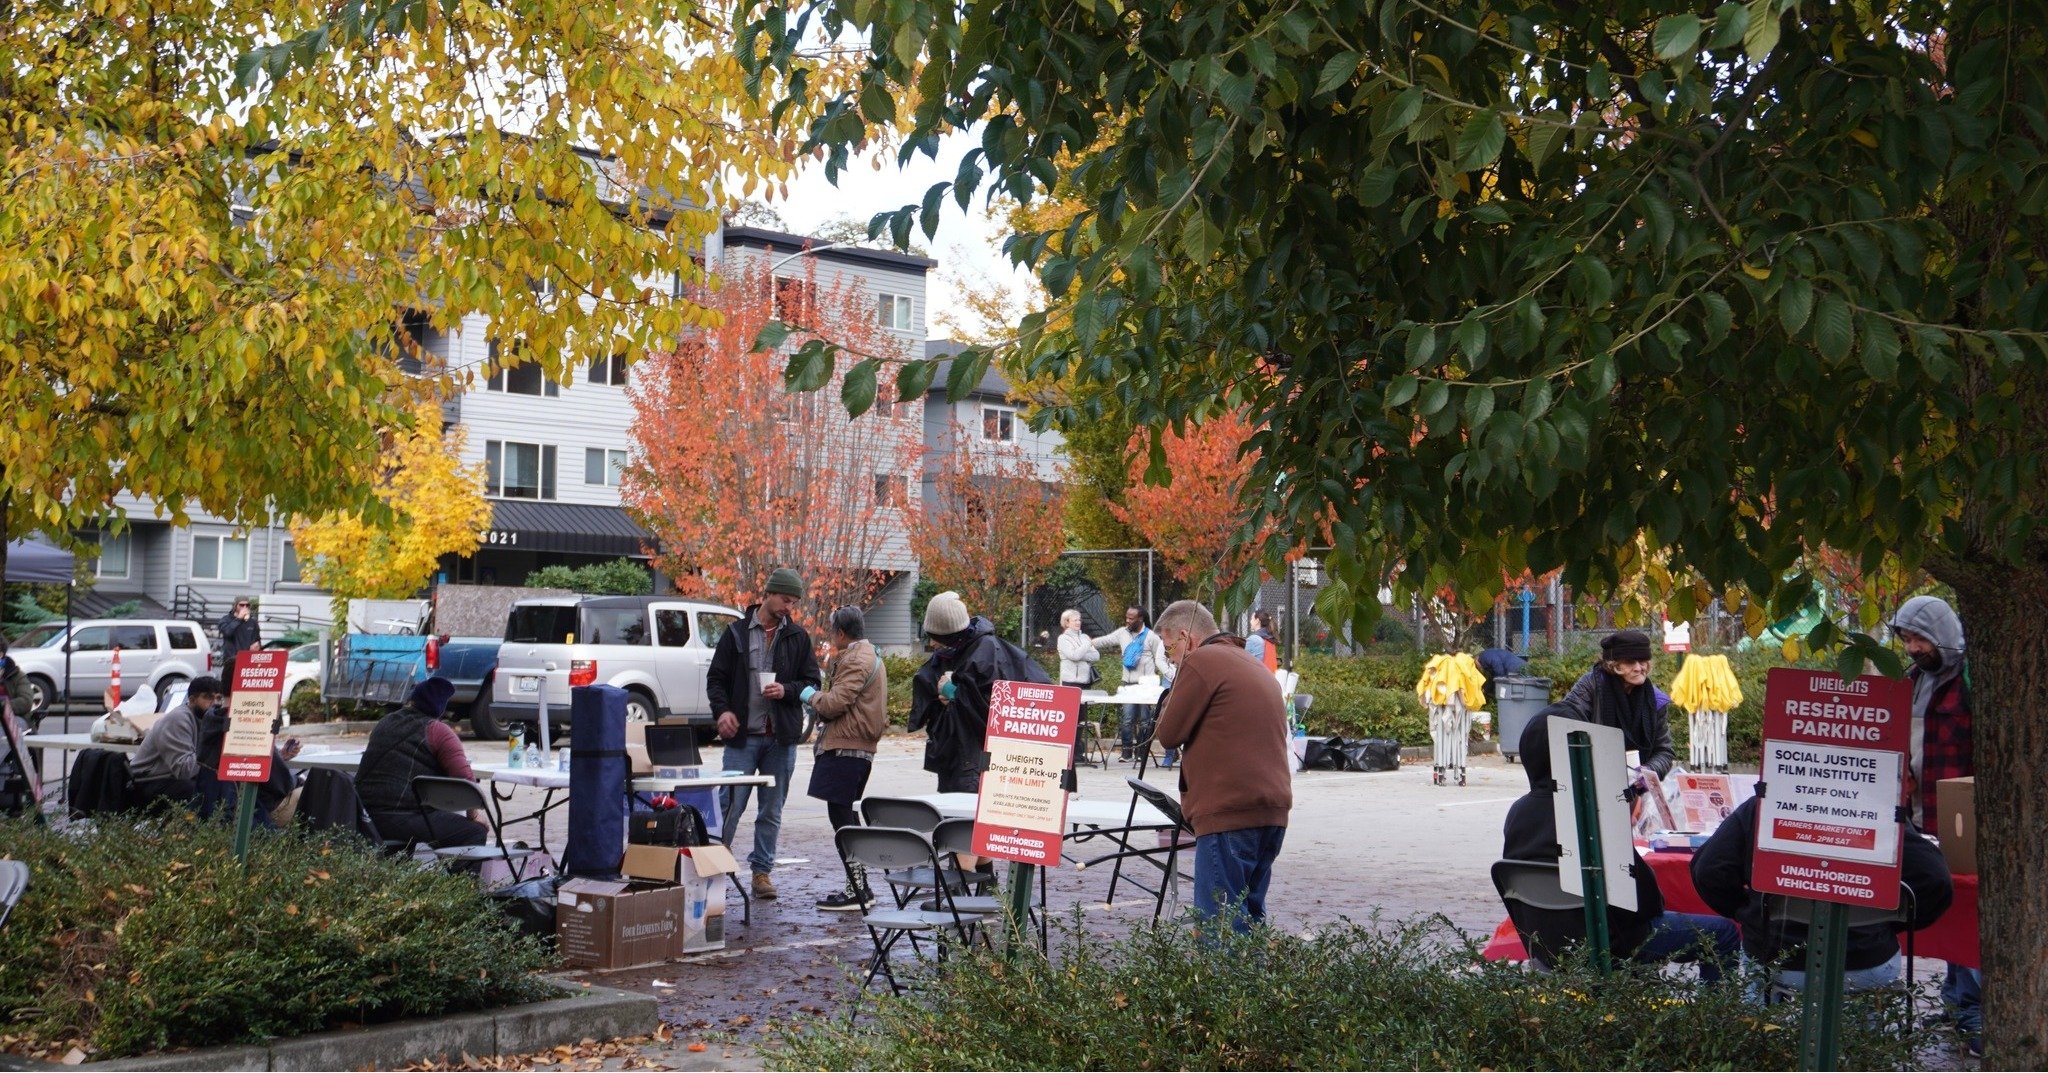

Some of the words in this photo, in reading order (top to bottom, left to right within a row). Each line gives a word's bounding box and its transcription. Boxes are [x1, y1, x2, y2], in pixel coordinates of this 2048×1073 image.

[480, 531, 517, 545] 5021
[241, 668, 278, 678] RESERVED
[242, 678, 274, 688] PARKING
[1017, 687, 1054, 700] UHEIGHTS
[1002, 706, 1066, 722] RESERVED
[1786, 699, 1890, 724] RESERVED
[1004, 721, 1058, 738] PARKING
[1792, 720, 1881, 741] PARKING
[1006, 754, 1044, 766] UHEIGHTS
[1775, 749, 1820, 764] SOCIAL
[1824, 754, 1877, 769] JUSTICE
[991, 763, 1020, 774] Drop-off
[1029, 768, 1058, 780] Pick-up
[1778, 764, 1806, 777] FILM
[1809, 766, 1876, 784] INSTITUTE
[1025, 778, 1046, 788] LIMIT
[1795, 785, 1828, 797] STAFF
[1830, 788, 1859, 800] ONLY
[1028, 804, 1049, 812] REQUEST
[1776, 801, 1798, 812] 7AM
[1806, 804, 1829, 815] 5PM
[1831, 807, 1878, 821] MON-FRI
[1778, 820, 1812, 831] FARMERS
[1813, 822, 1845, 834] MARKET
[1846, 826, 1869, 837] ONLY
[989, 834, 1044, 849] UNAUTHORIZED
[1795, 832, 1812, 842] 7AM
[1816, 834, 1833, 844] 2PM
[1834, 836, 1851, 846] SAT
[986, 842, 1018, 855] VEHICLES
[1020, 848, 1046, 859] TOWED
[1780, 864, 1871, 886] UNAUTHORIZED
[1776, 876, 1830, 894] VEHICLES
[1833, 884, 1874, 900] TOWED
